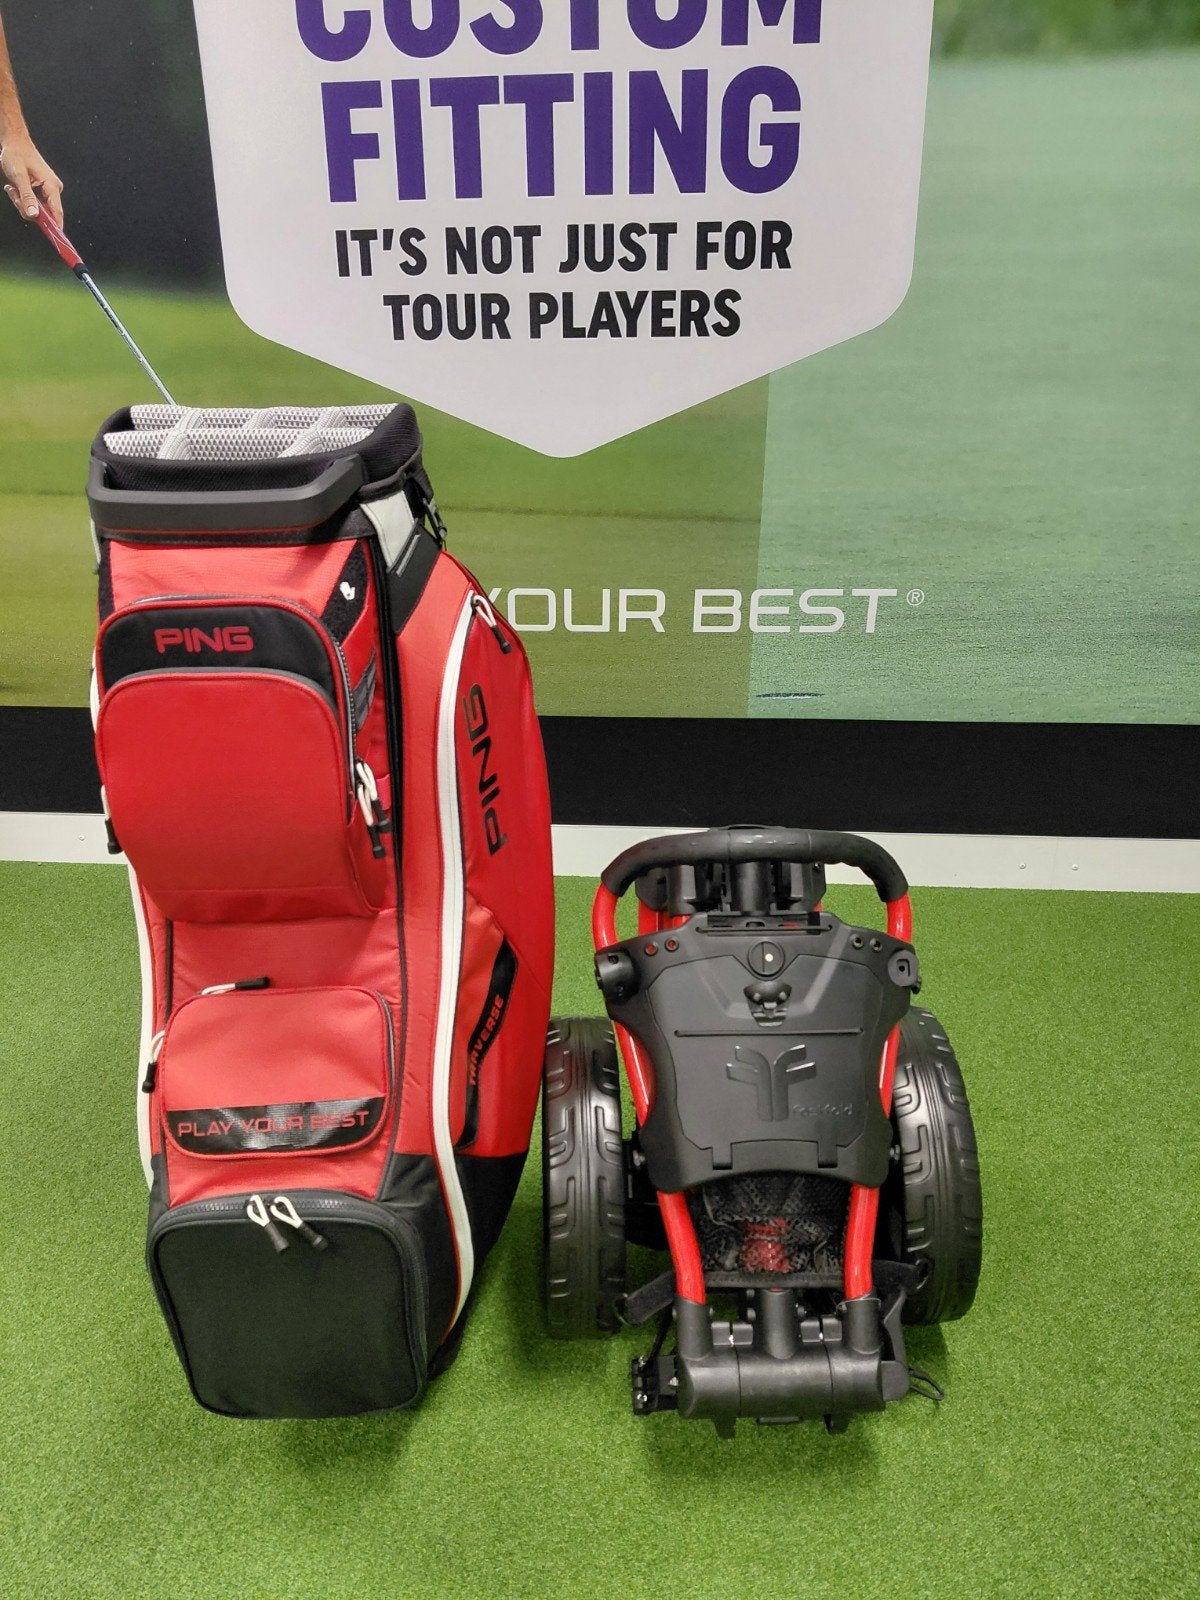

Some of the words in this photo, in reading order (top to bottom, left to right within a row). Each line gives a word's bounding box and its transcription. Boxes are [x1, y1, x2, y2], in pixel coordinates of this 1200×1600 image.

[321, 65, 801, 202] FITTING
[335, 227, 427, 277] IT'S
[445, 225, 541, 275] NOT
[559, 222, 677, 273] JUST
[696, 220, 793, 270] FOR
[383, 293, 511, 341] TOUR
[529, 288, 742, 338] PLAYERS
[487, 587, 666, 633] OUR
[154, 625, 254, 654] PING
[462, 683, 508, 857] PING
[469, 994, 504, 1086] TRAVERSE
[177, 1121, 234, 1138] PLAY
[241, 1115, 303, 1134] YOUR
[310, 1109, 370, 1130] BEST
